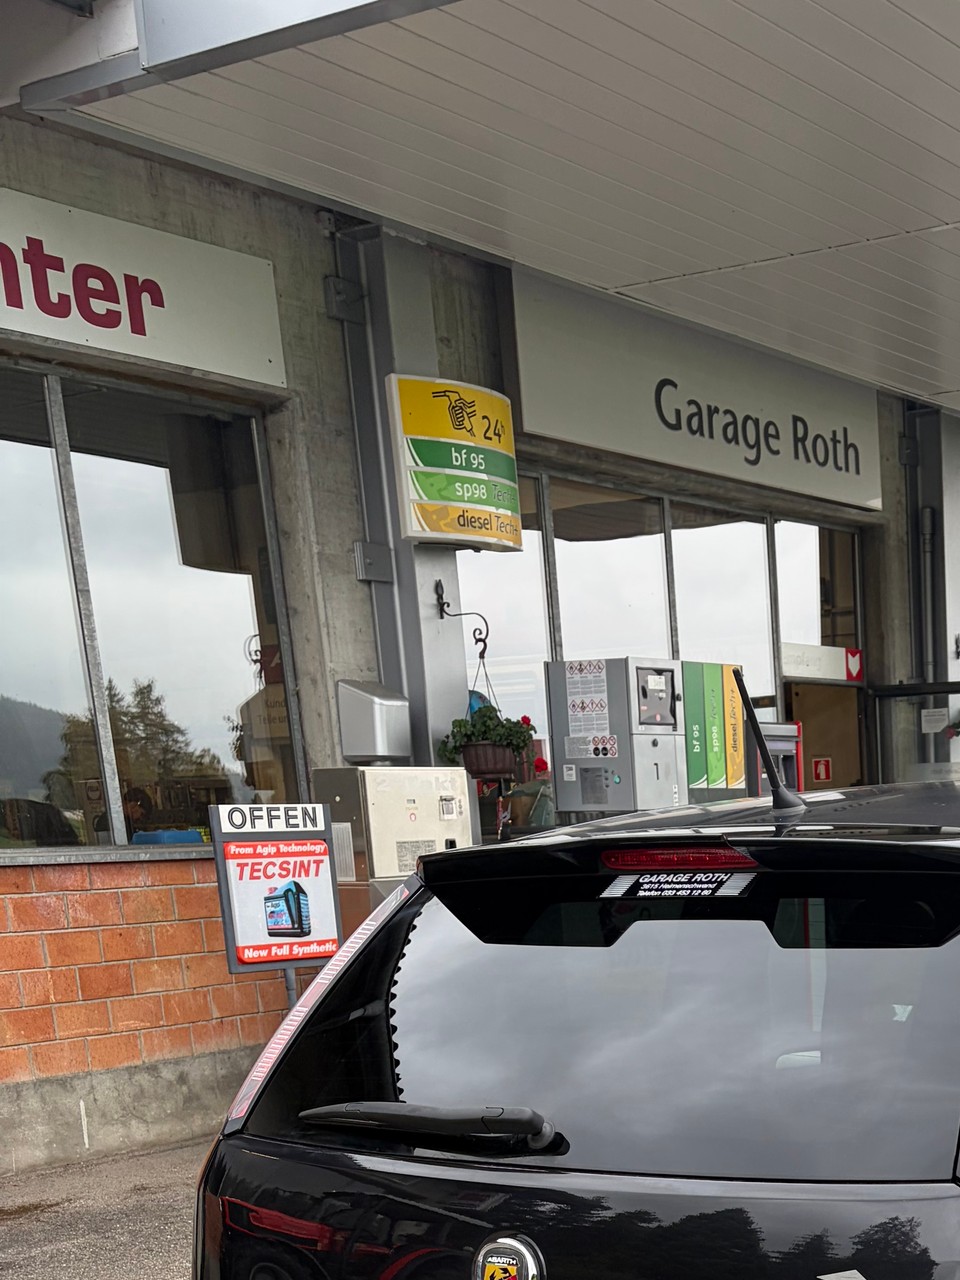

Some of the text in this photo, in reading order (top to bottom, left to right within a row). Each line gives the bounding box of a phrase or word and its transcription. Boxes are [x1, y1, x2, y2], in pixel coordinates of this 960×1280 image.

[654, 377, 861, 476] Garage Roth
[451, 447, 486, 470] bf 95
[455, 482, 487, 500] sp98
[457, 510, 493, 531] diesel
[227, 806, 319, 830] OFFEN
[230, 843, 327, 856] From Agip Technology
[236, 859, 325, 881] TECSINT
[638, 873, 731, 883] GARAGE ROTH
[244, 941, 339, 959] New Full Synthetic
[486, 1256, 517, 1265] ABARTH
